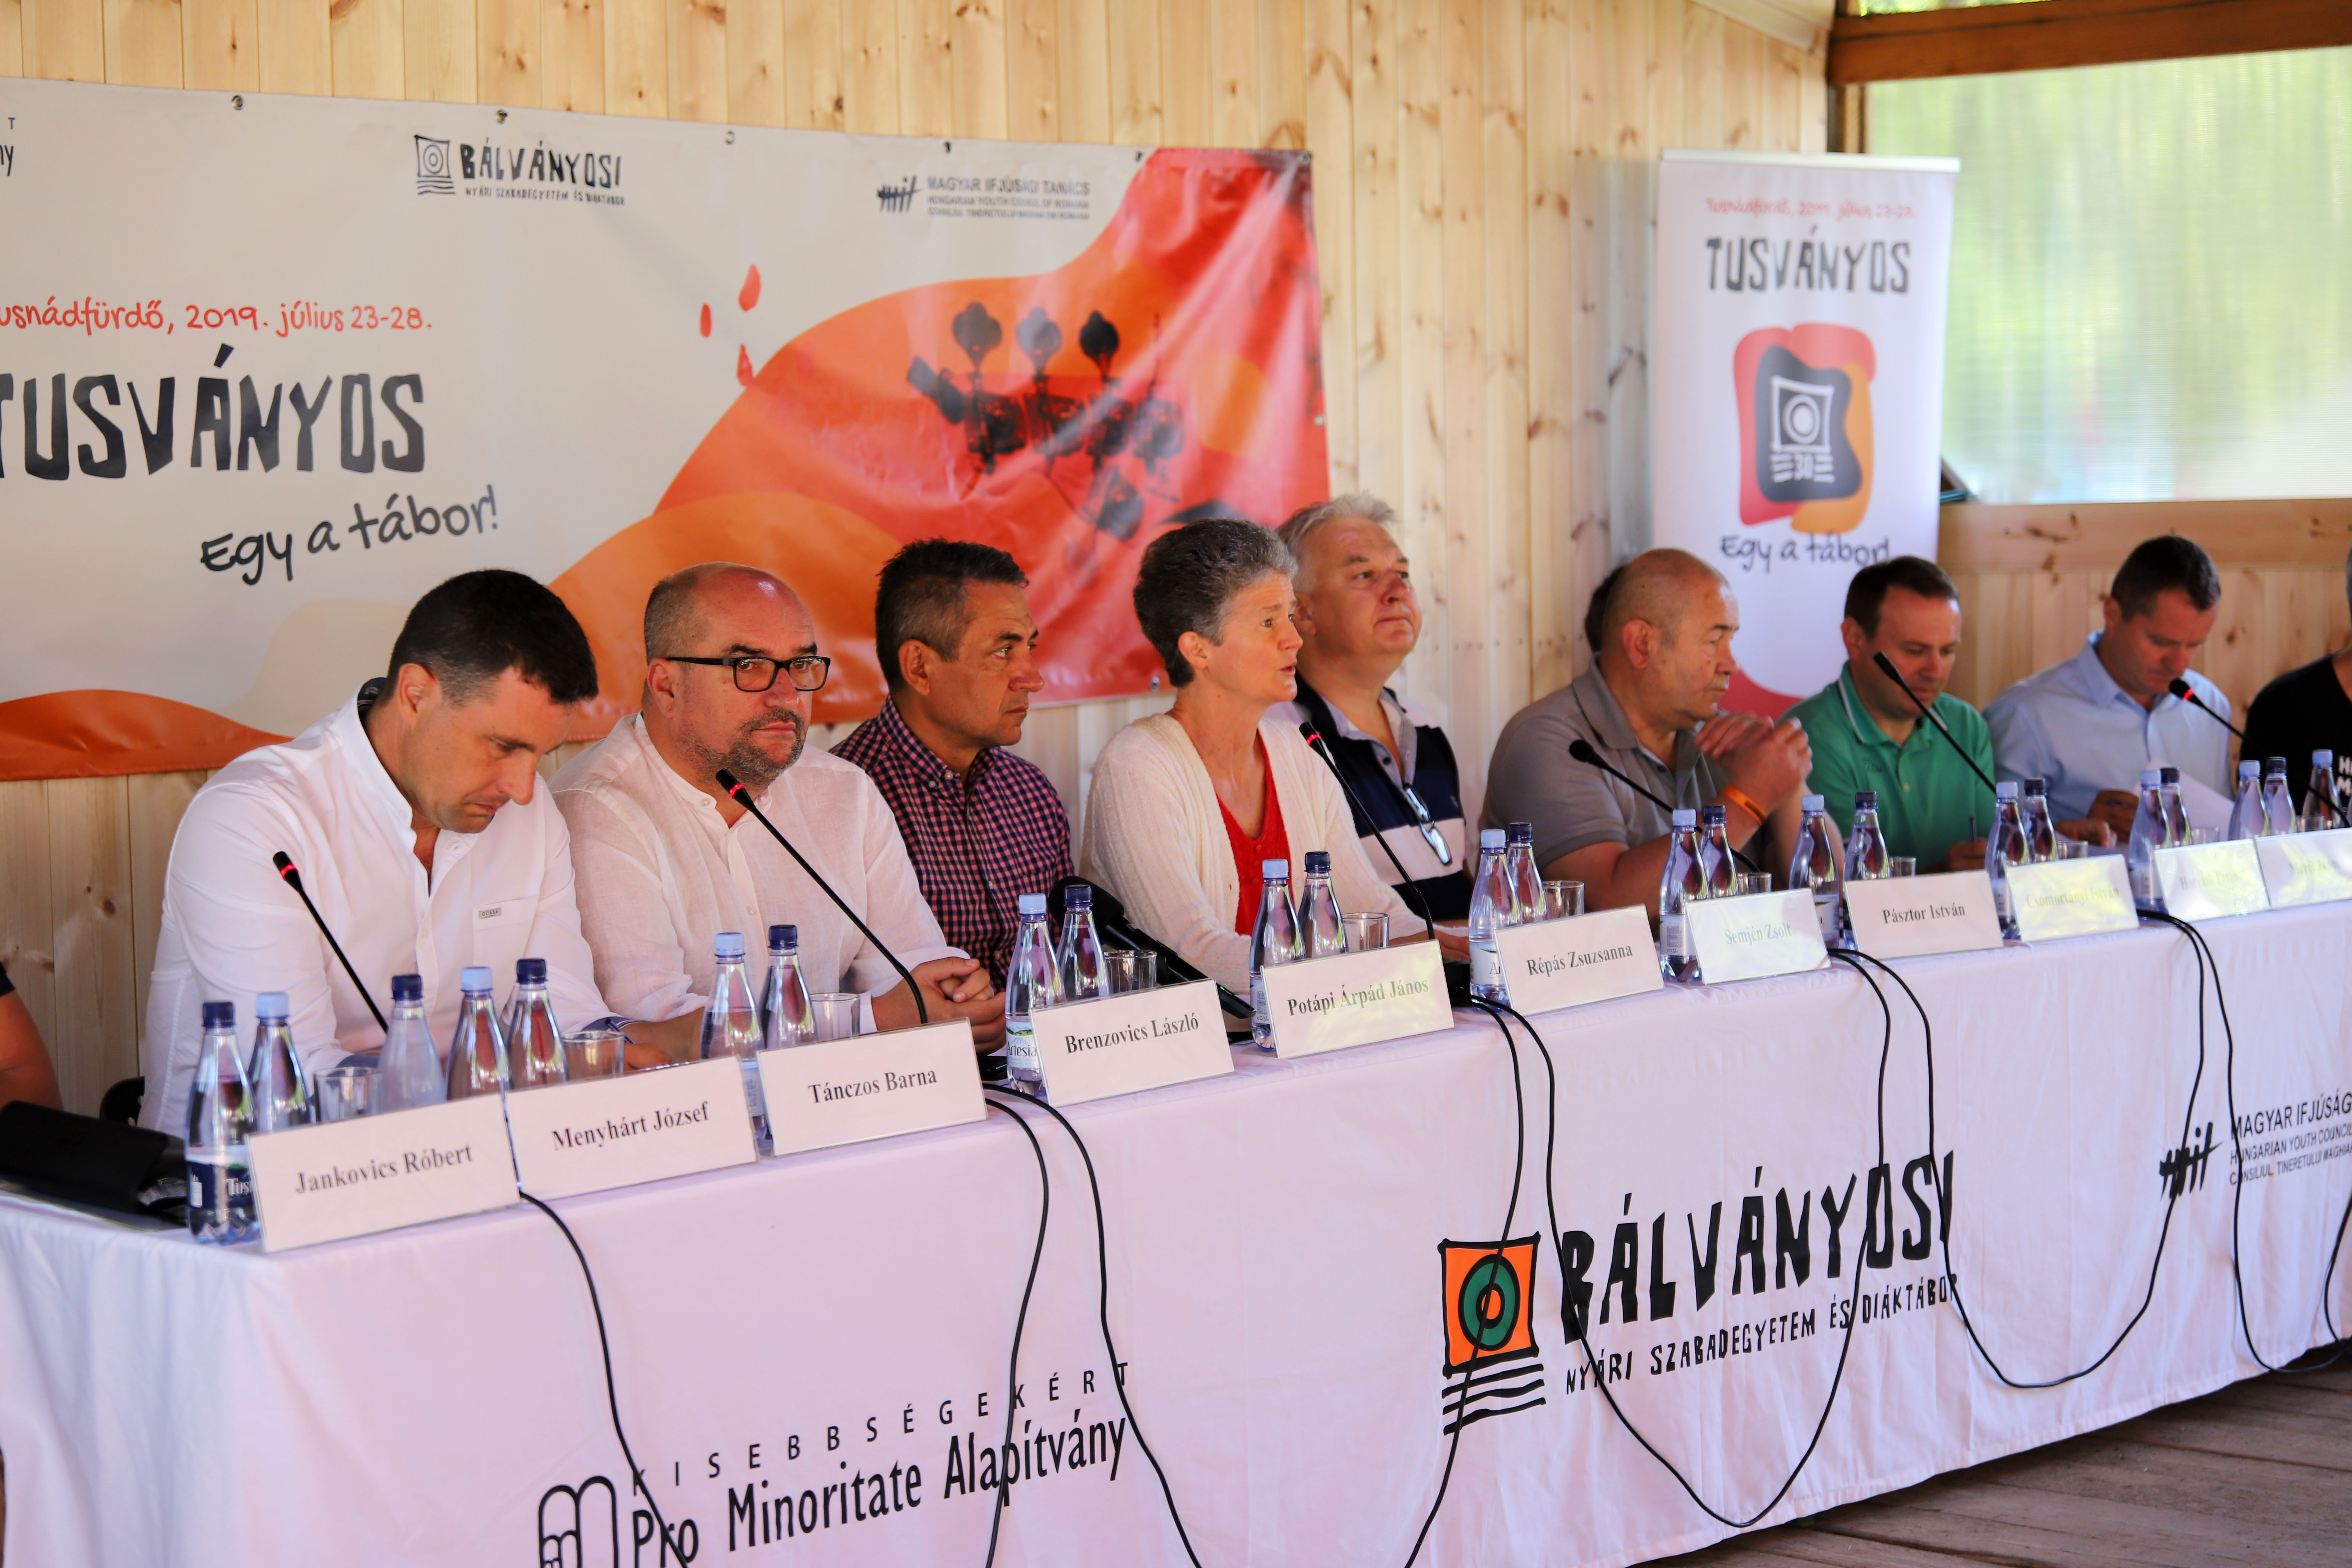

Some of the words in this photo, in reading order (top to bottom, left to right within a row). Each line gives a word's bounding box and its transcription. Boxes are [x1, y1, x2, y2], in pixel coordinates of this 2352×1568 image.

[460, 137, 622, 188] BÁLVÁNYOSI
[1706, 225, 1910, 294] TUSVÁNYOS
[186, 305, 268, 332] 2019.
[274, 301, 344, 337] július
[351, 305, 432, 331] 23-28.
[200, 531, 293, 586] Egy
[308, 521, 340, 554] a
[349, 485, 499, 551] tábor!
[1721, 535, 1772, 574] Egy
[1781, 538, 1799, 561] a
[1882, 905, 1926, 924] Pásztor
[1929, 902, 1966, 919] István
[1724, 925, 1763, 946] Semjén
[1764, 922, 1792, 939] Zsolt
[1525, 954, 1566, 978] Répás
[1568, 944, 1633, 968] Zsuzsanna
[1286, 992, 1336, 1017] Potápi
[1340, 982, 1386, 1012] Árpád
[1389, 979, 1429, 999] János
[1064, 1023, 1148, 1054] Brenzovics
[1151, 1012, 1199, 1040] László
[808, 1077, 880, 1104] Tánczos
[884, 1070, 937, 1092] Barna
[551, 1115, 648, 1151] Menyhárt
[653, 1101, 710, 1131] József
[2231, 1106, 2292, 1140] MAGYAR
[2289, 1132, 2317, 1151] YOUTH
[295, 1159, 398, 1194] Jankovics
[403, 1143, 475, 1175] Róbert
[2230, 1164, 2274, 1185] CNSILIUL
[1561, 1150, 1954, 1344] BÁLVÁNYOSI
[1566, 1348, 1632, 1395] NYÁRI
[1651, 1314, 1816, 1375] SZABADEGYETEM
[1830, 1293, 1850, 1330] ÉS
[633, 1509, 699, 1568] Pro
[727, 1459, 923, 1552] Minoritate
[943, 1408, 1126, 1507] Alapítvány
